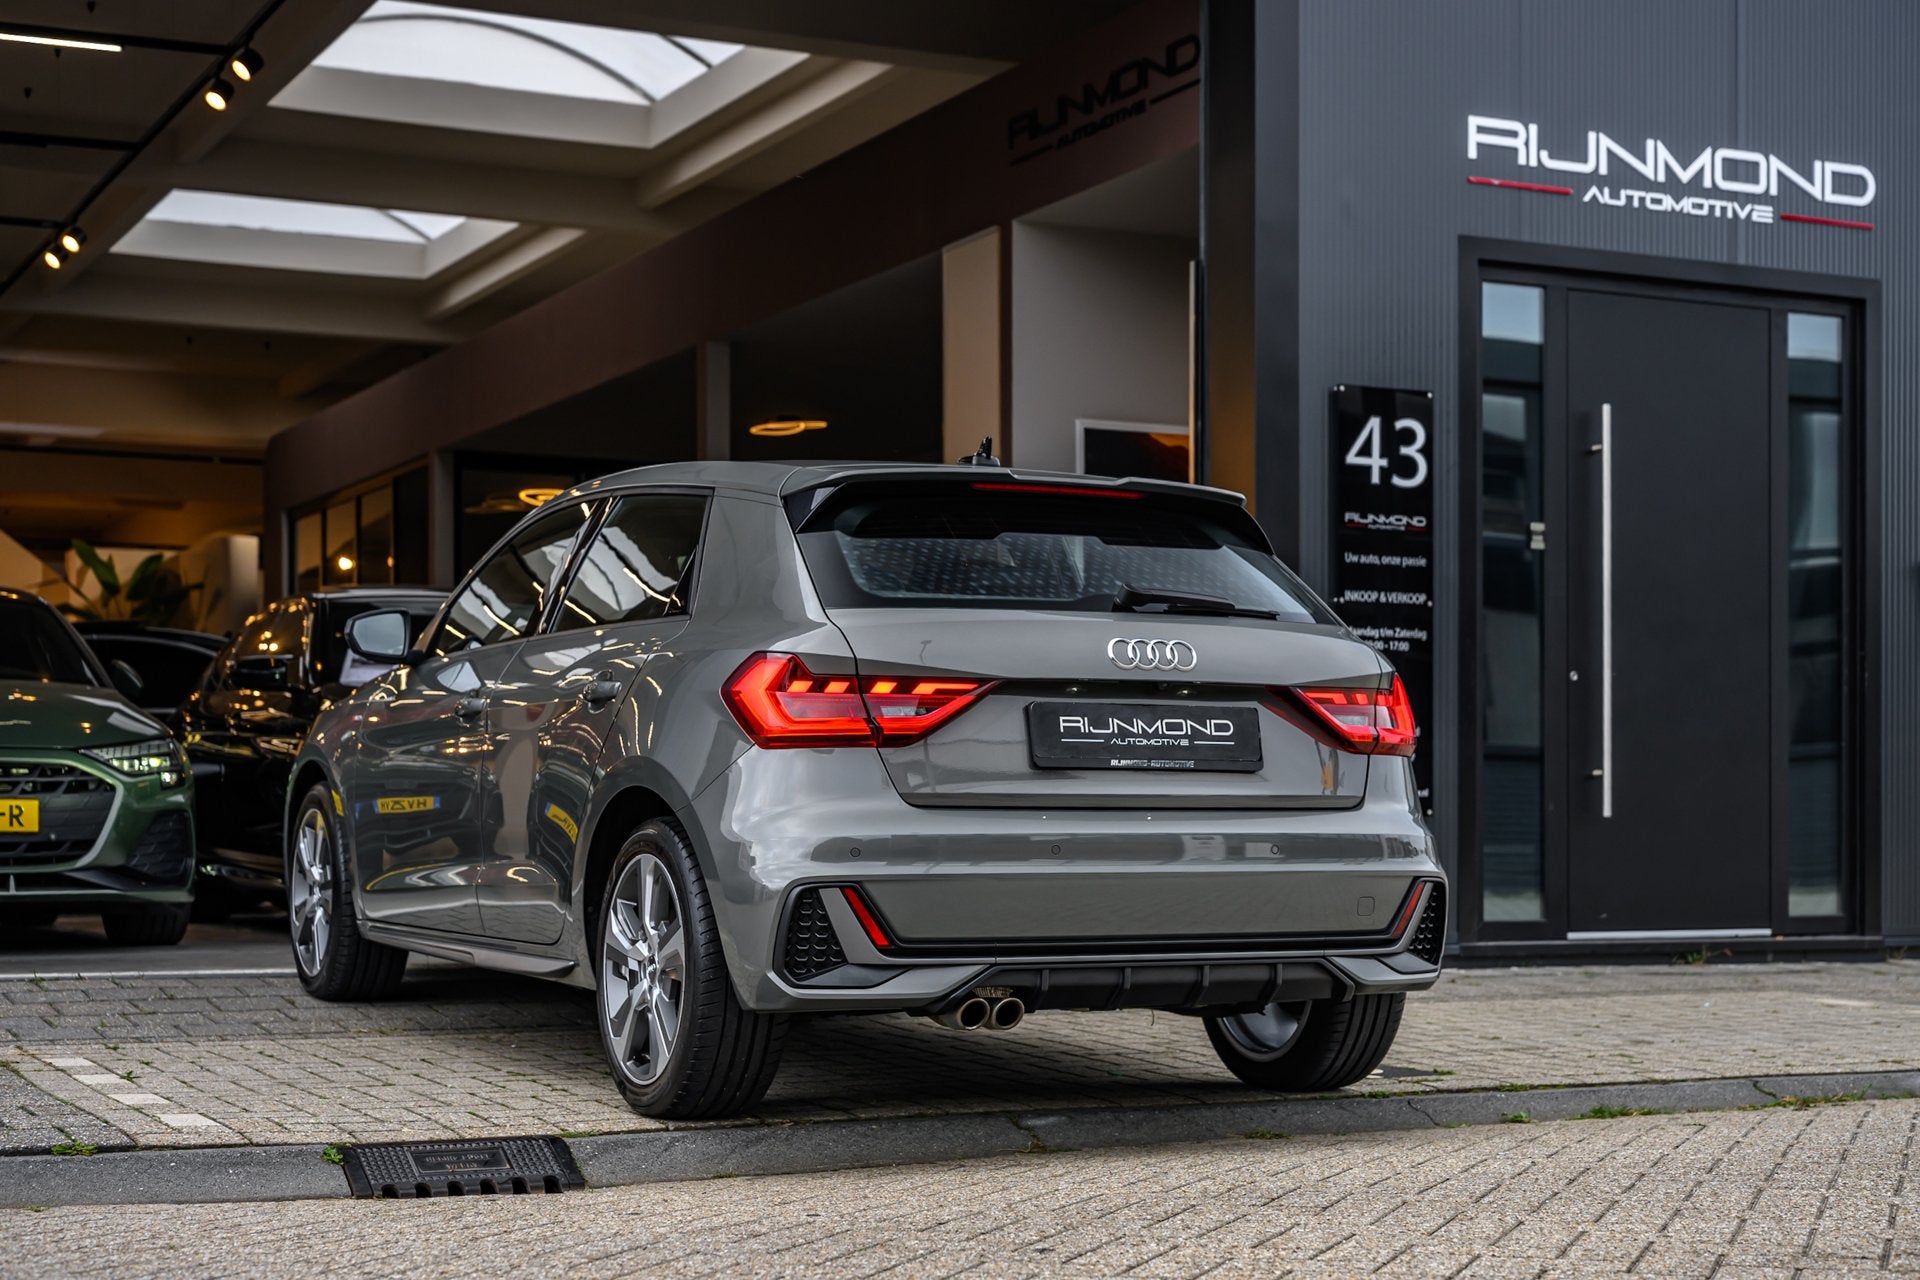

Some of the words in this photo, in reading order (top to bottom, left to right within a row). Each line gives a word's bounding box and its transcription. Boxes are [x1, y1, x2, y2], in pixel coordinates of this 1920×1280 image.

[1467, 114, 1877, 207] RIJNMOND
[1582, 184, 1774, 224] AUTOMOTIVE
[1345, 414, 1429, 488] 43
[1344, 511, 1427, 527] RIJNMOND
[1344, 551, 1359, 563] Uw
[1360, 553, 1380, 566] auto,
[1381, 555, 1401, 566] onze
[1402, 555, 1427, 568] passie
[1344, 589, 1379, 602] INKOOP
[1380, 591, 1387, 603] &
[1387, 592, 1427, 605] VERKOOP
[1380, 627, 1394, 637] t/m
[1394, 627, 1427, 641] Zaterdag
[1389, 641, 1410, 652] 17:00
[1059, 716, 1234, 736] RIJNMOND
[1110, 738, 1190, 746] AUTOMOTIVE
